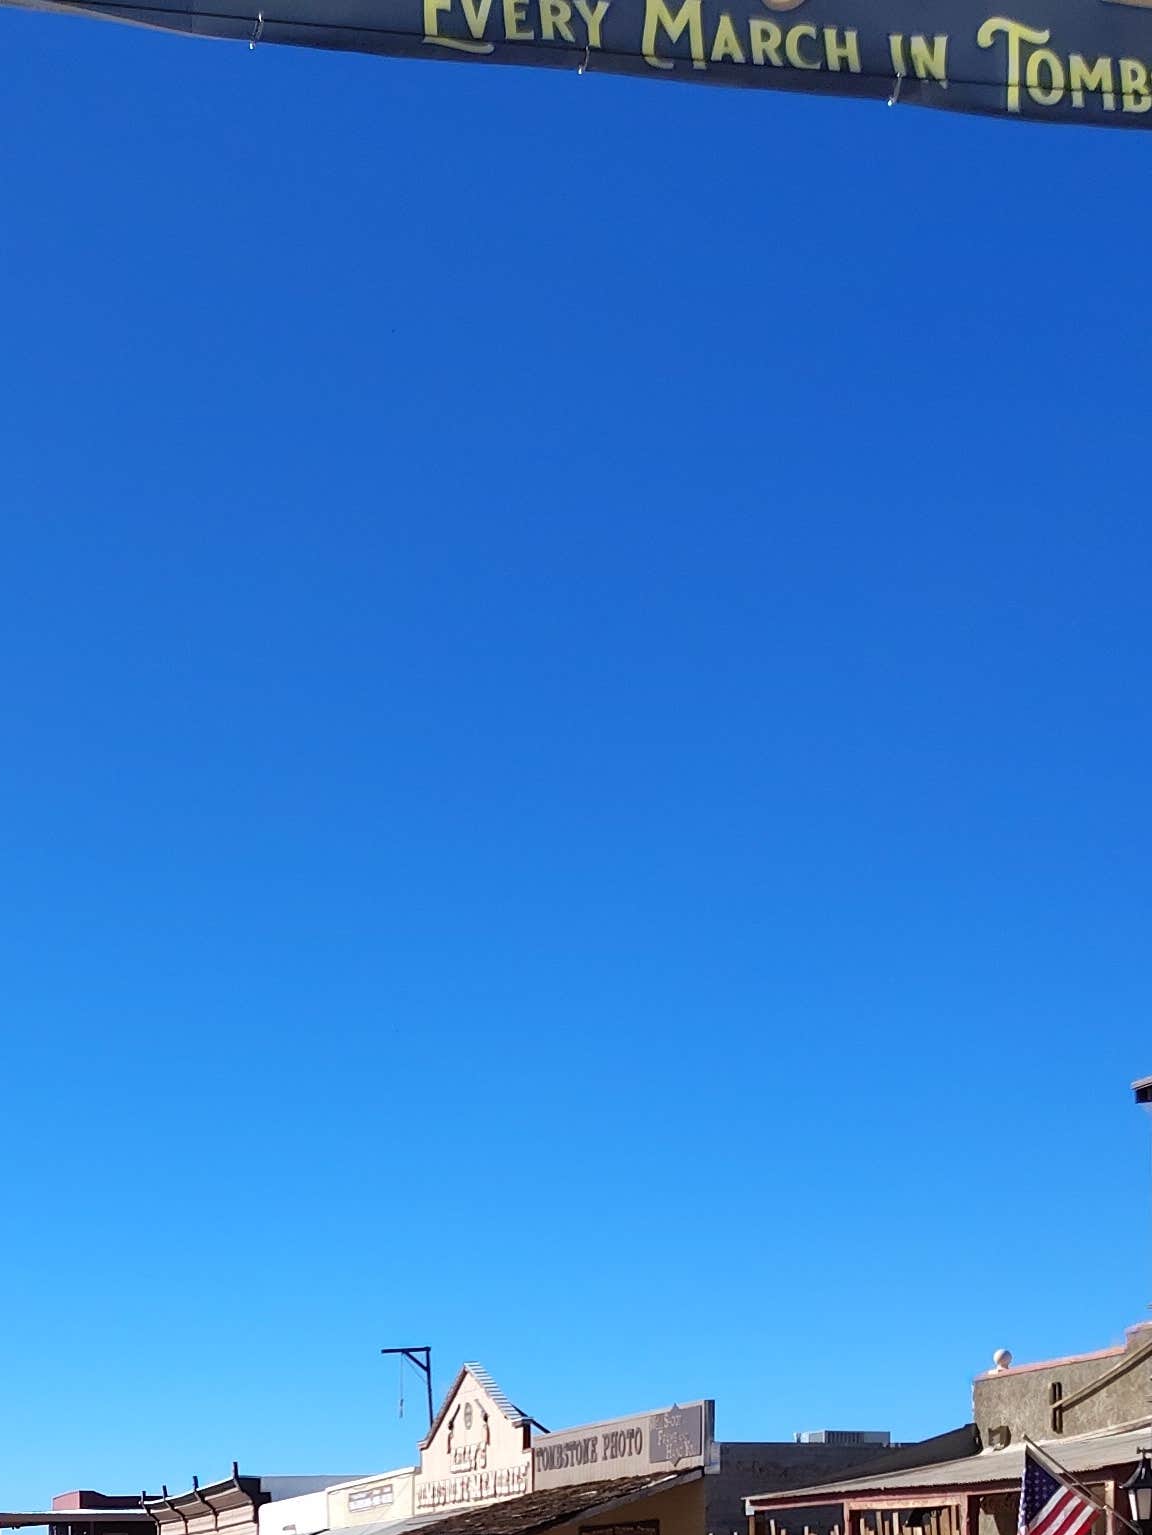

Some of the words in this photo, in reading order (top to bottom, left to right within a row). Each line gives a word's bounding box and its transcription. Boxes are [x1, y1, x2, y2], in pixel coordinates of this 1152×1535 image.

[422, 0, 609, 54] EVERY
[641, 0, 862, 74] MARCH
[889, 34, 948, 90] IN
[535, 1436, 598, 1472] TOMBSTONE
[601, 1427, 644, 1461] PHOTO
